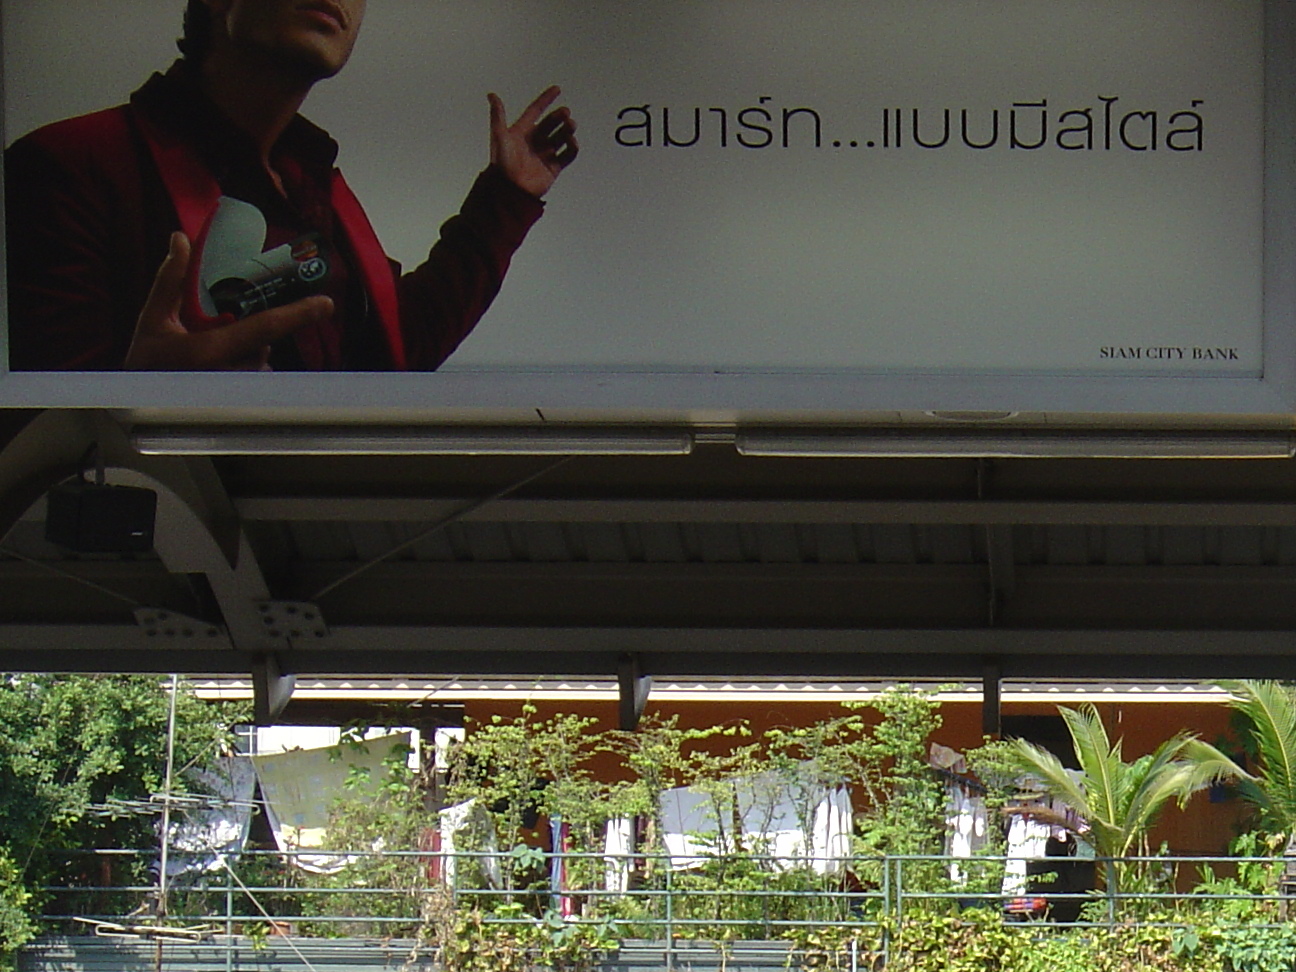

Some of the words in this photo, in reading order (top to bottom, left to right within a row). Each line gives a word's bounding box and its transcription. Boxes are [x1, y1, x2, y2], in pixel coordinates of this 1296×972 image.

[1100, 346, 1142, 359] SIAM
[1146, 347, 1187, 360] CITY
[1192, 347, 1239, 361] BANK
